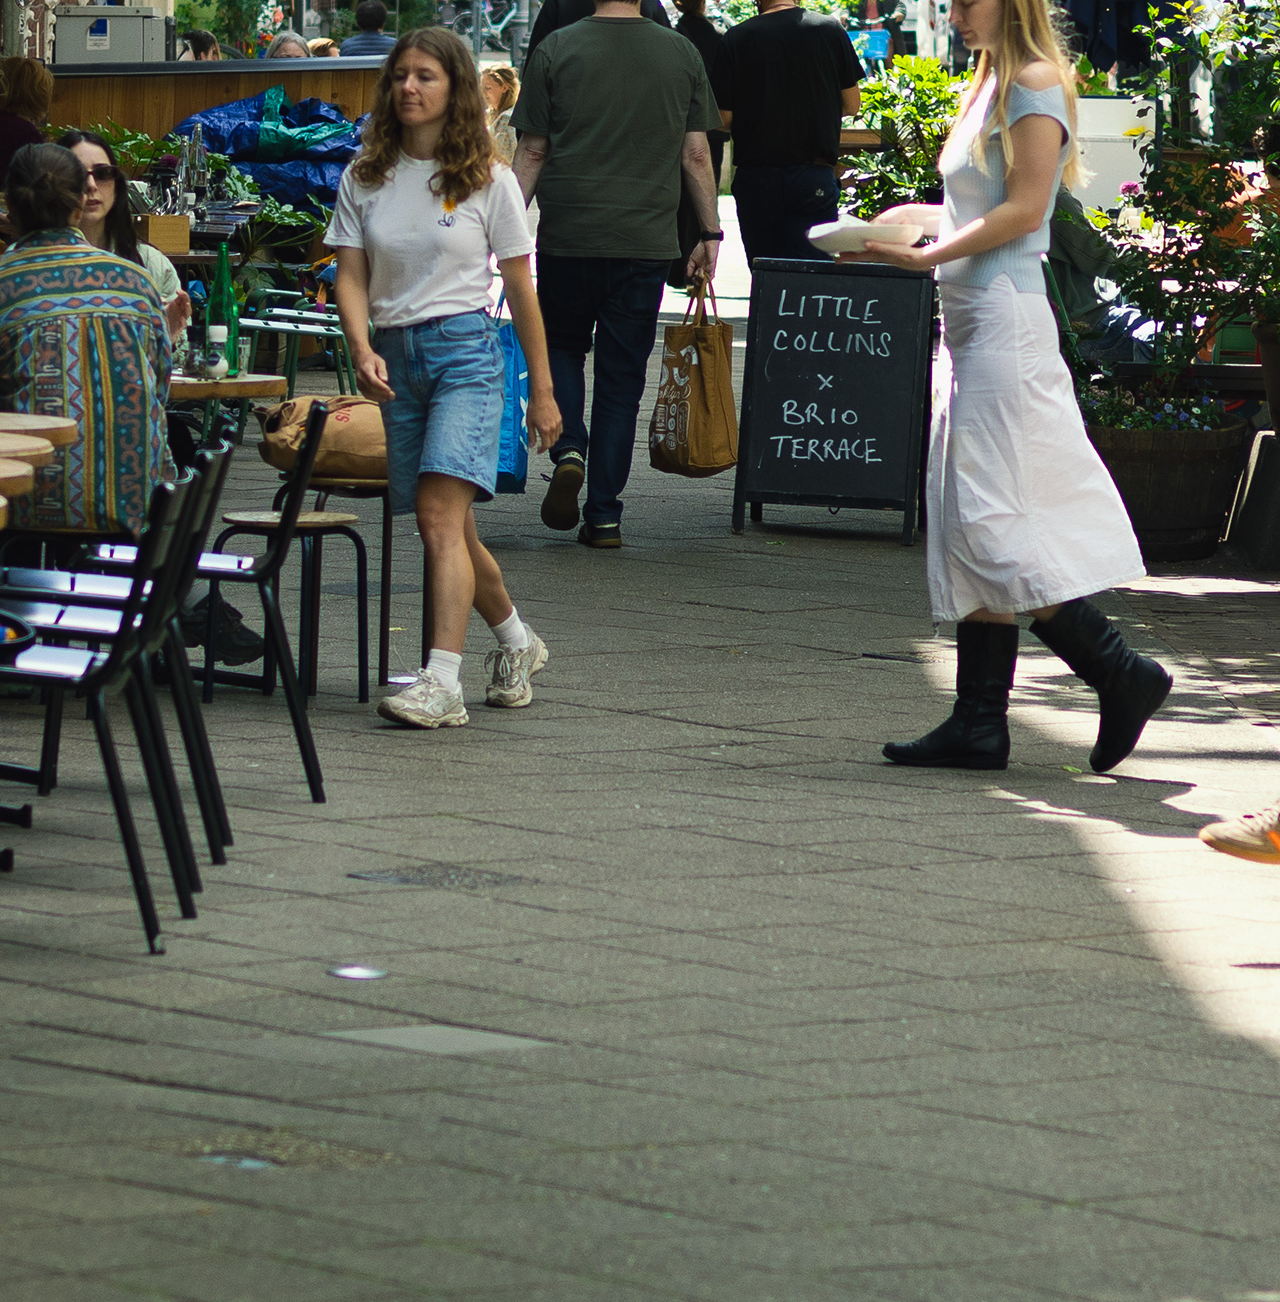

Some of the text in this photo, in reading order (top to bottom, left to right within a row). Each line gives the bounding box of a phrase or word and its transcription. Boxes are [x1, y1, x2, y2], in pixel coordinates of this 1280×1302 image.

[778, 289, 881, 323] LITTLE
[773, 330, 891, 357] COLLINS
[782, 399, 858, 425] BRIO
[770, 435, 882, 463] TERRACE
